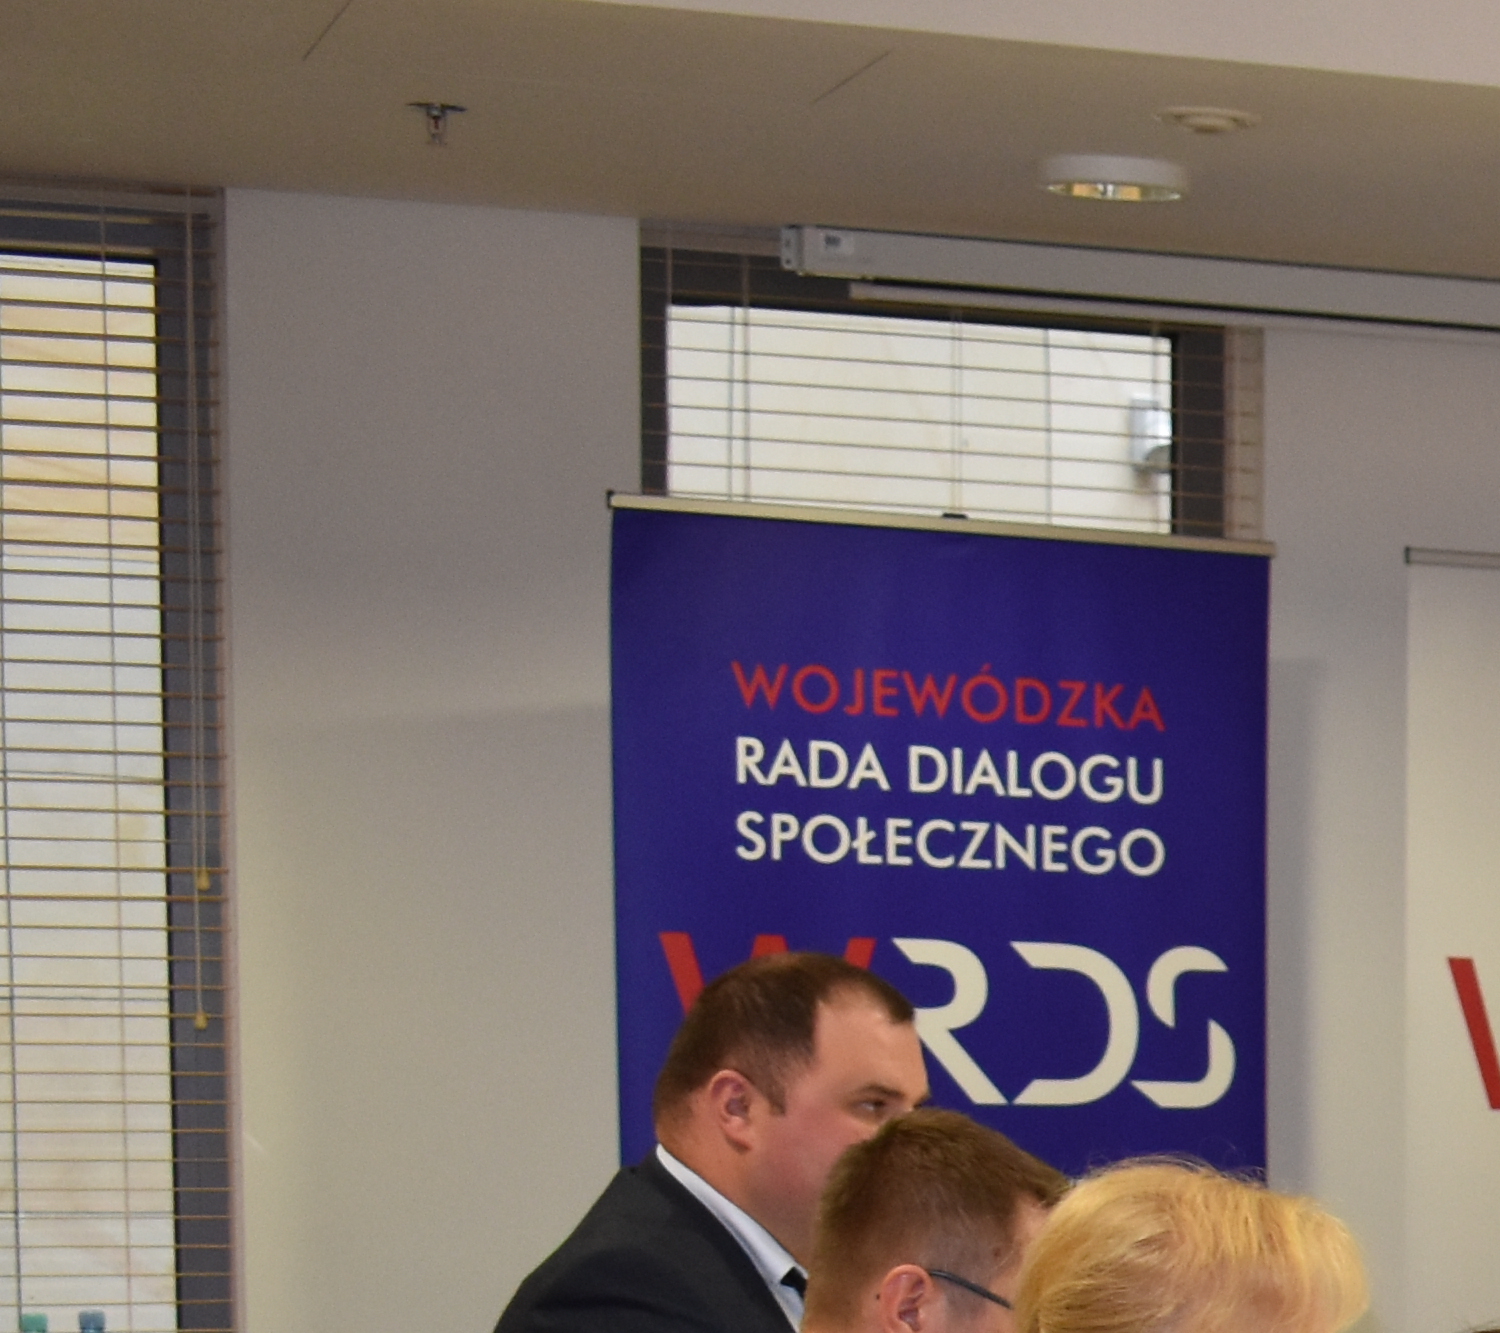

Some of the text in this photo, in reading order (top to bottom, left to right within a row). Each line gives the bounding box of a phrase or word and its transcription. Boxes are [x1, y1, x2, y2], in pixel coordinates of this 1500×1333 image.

[731, 661, 1165, 732] WOJEWÓDZKA
[735, 736, 1164, 804] RADA DIALOGU
[735, 811, 1166, 876] SPOŁECZNEGO
